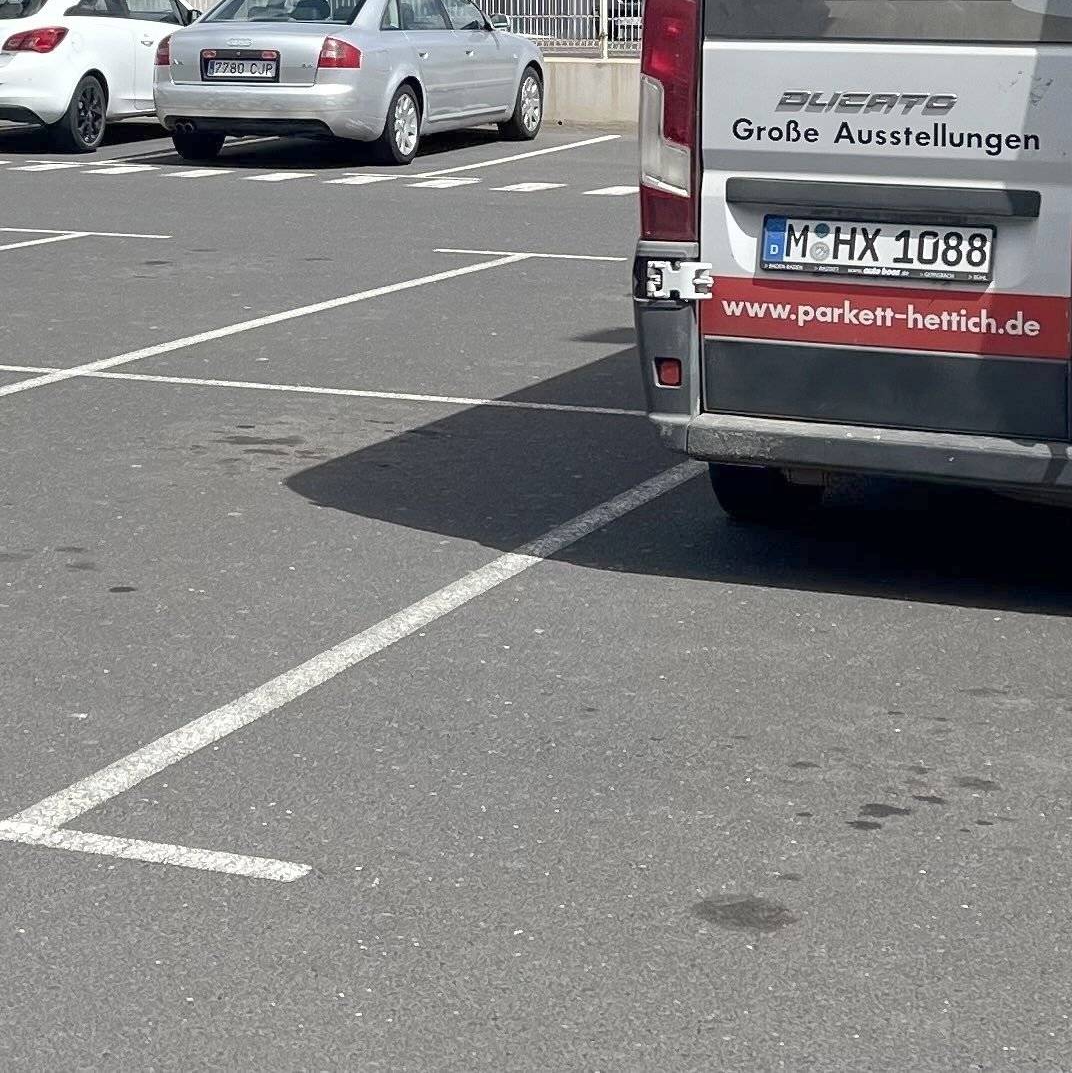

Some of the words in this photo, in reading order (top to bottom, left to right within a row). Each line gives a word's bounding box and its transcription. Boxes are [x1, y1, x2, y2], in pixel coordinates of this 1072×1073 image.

[213, 61, 245, 75] 7780
[249, 61, 274, 77] CJP
[775, 90, 958, 116] DUCATO
[732, 117, 820, 143] Große
[833, 121, 1041, 156] Ausstellungen
[785, 223, 811, 258] M
[832, 226, 883, 262] HX
[893, 229, 988, 267] 1088
[721, 299, 1041, 337] www.parkett-hettich.de
